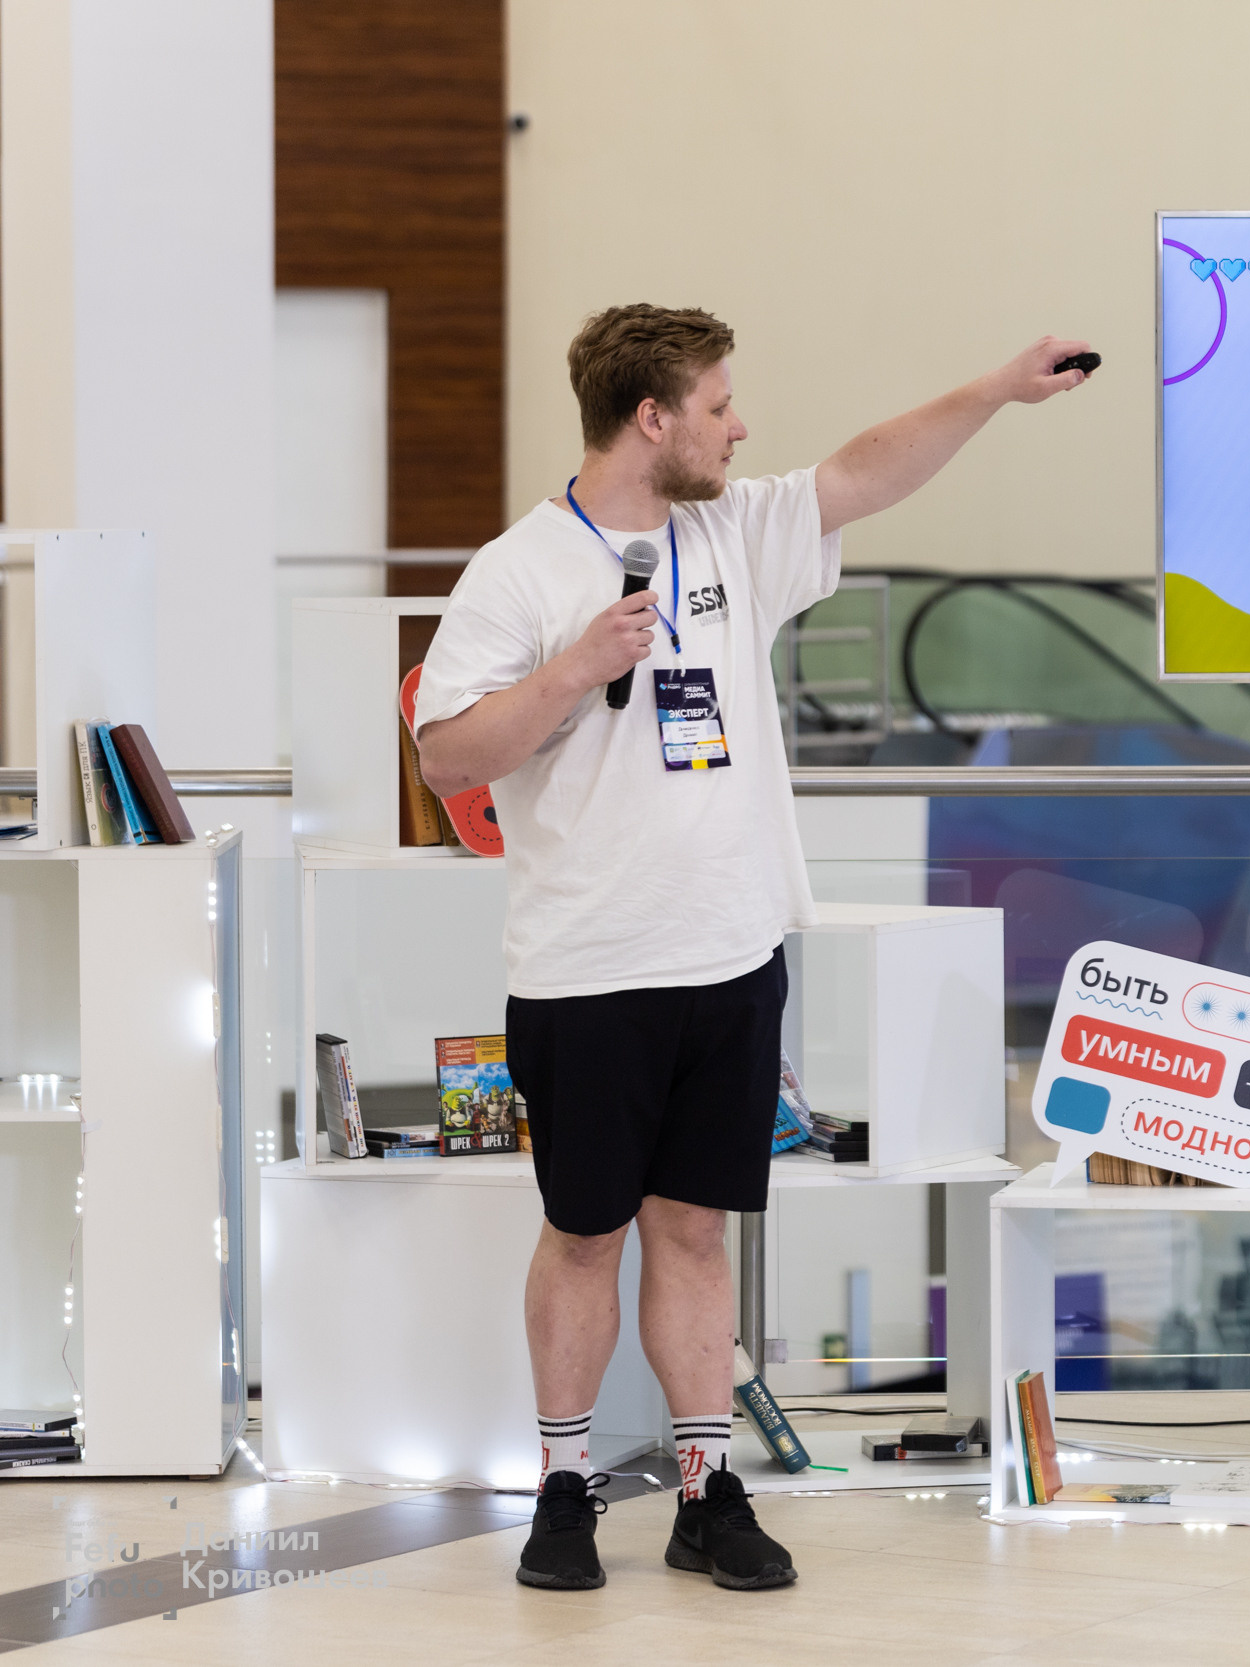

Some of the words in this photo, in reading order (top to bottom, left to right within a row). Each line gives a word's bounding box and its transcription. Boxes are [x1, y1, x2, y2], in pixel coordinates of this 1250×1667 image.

[668, 708, 709, 718] ЭКСПЕРТ
[1080, 957, 1169, 1005] быть
[1078, 1028, 1212, 1084] умным
[450, 1136, 471, 1150] ШРЕК
[482, 1134, 502, 1148] ШРЕК
[504, 1134, 510, 1146] 2
[748, 1392, 775, 1431] ВЛАДЕТЬ
[752, 1382, 782, 1427] ВОСТОКОМ
